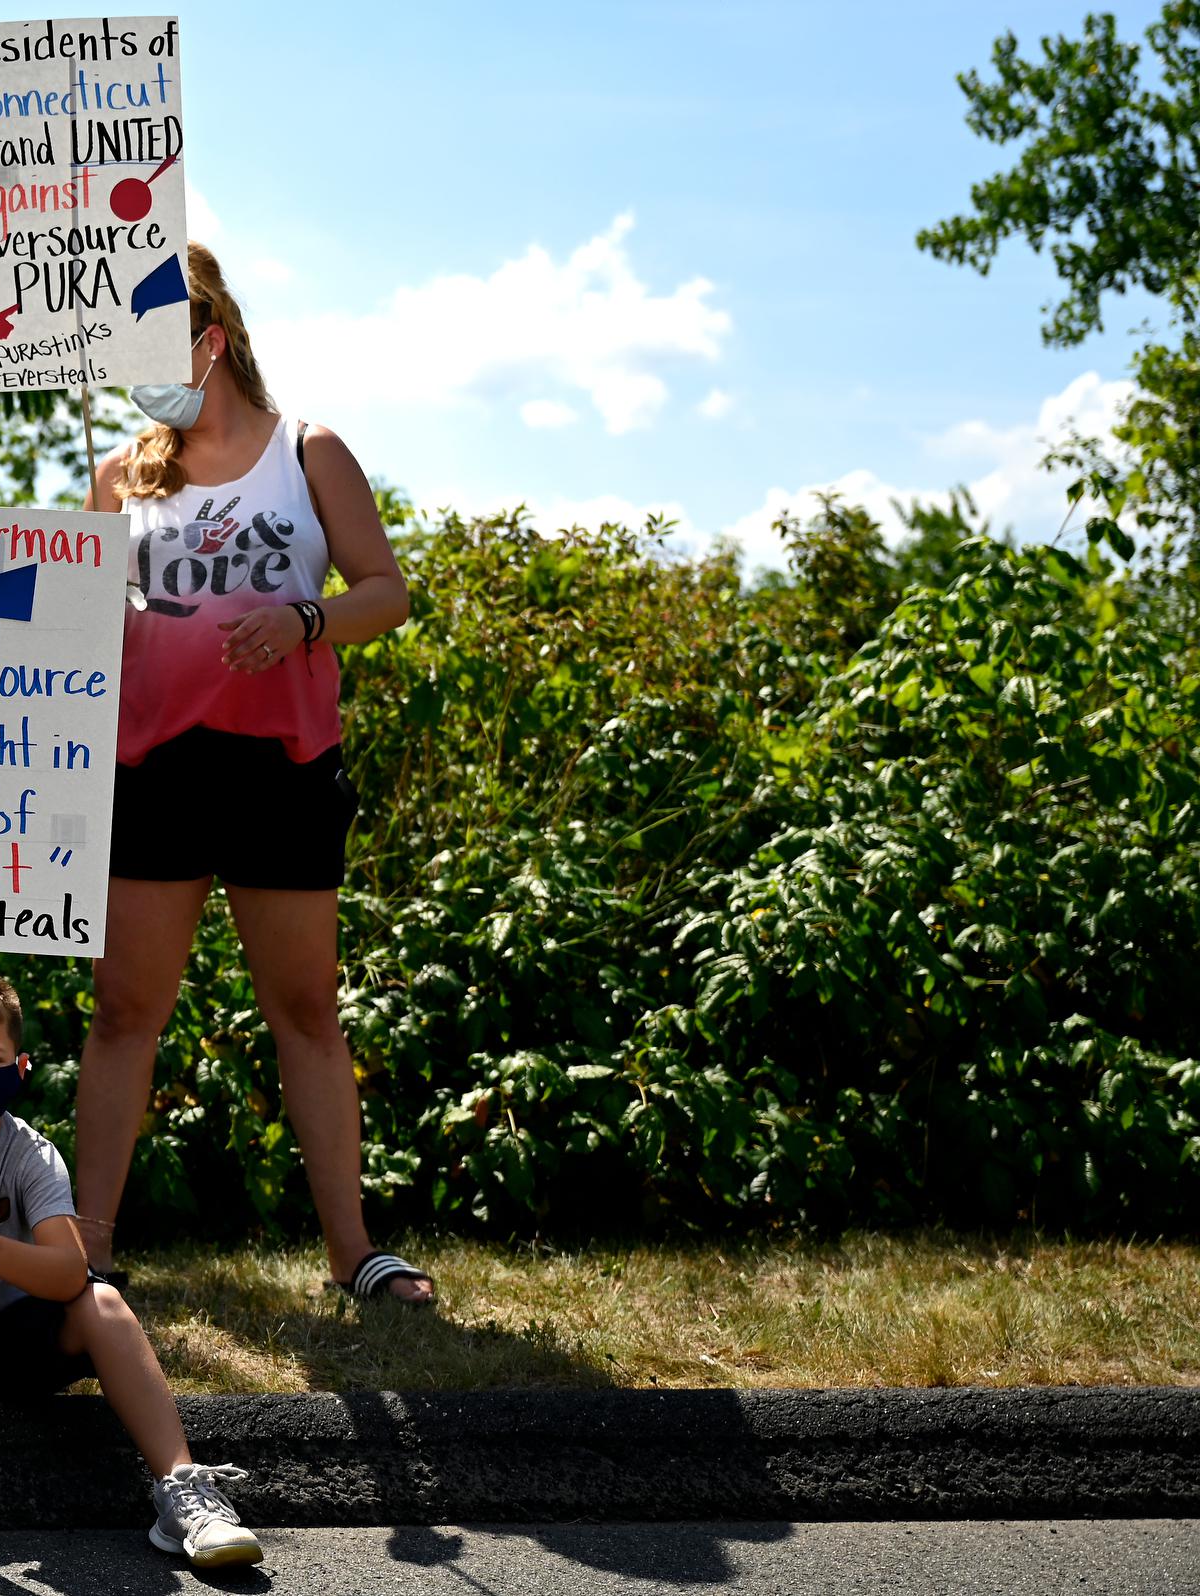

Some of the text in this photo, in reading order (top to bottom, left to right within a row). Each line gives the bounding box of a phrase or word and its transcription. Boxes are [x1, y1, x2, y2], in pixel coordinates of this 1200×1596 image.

[149, 20, 178, 57] of
[71, 115, 183, 164] UNITED
[14, 257, 121, 314] PURA
[137, 526, 291, 618] Love
[53, 734, 90, 769] in
